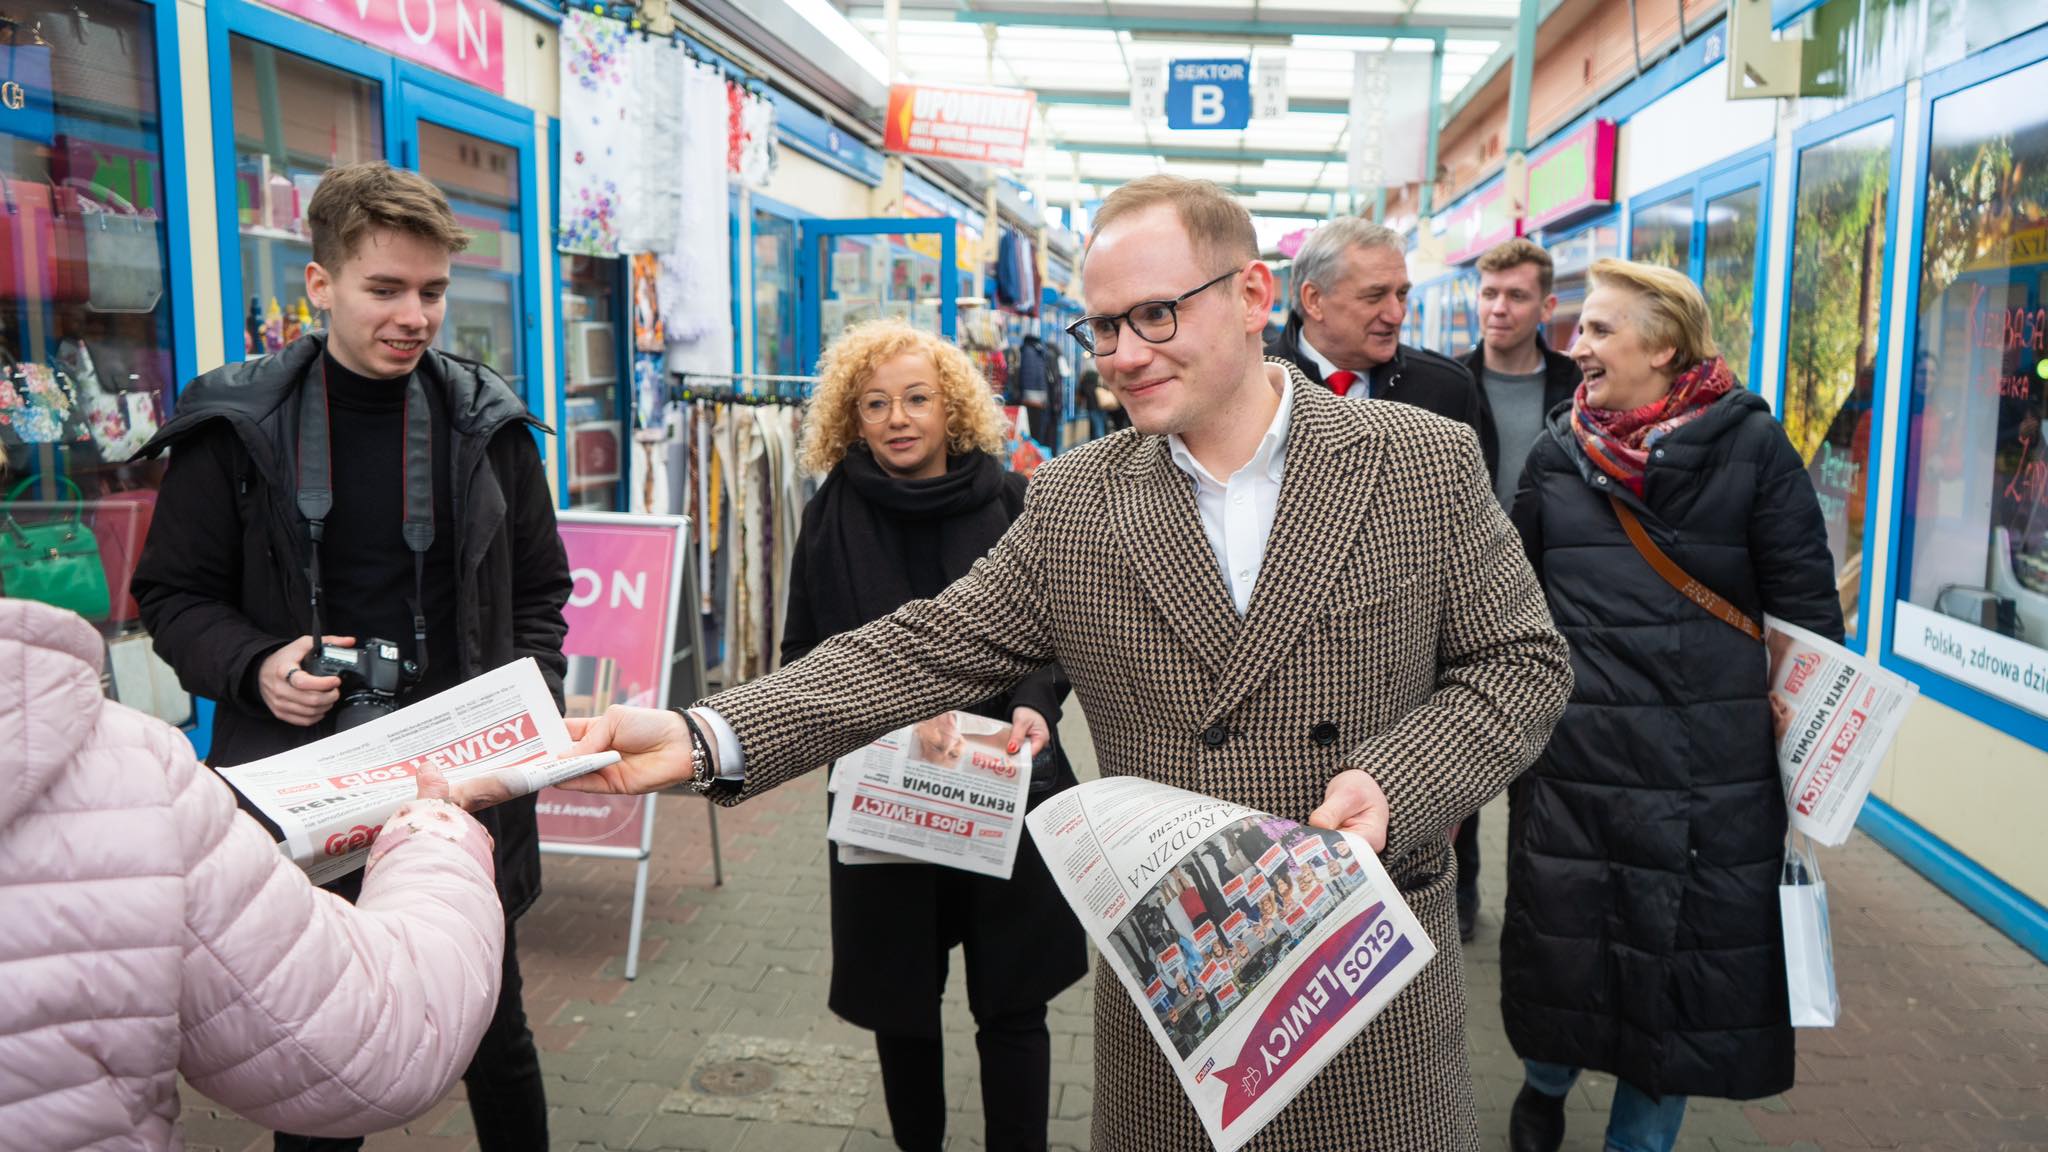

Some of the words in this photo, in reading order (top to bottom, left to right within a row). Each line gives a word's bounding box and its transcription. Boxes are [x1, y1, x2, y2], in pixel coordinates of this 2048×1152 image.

[1174, 64, 1245, 81] SEKTOR
[1190, 84, 1227, 125] B
[1924, 627, 1966, 668] Polska,
[1969, 645, 2020, 682] zdrowa
[1824, 664, 1856, 708] RENTA
[1790, 708, 1831, 765] WDOWIA
[902, 775, 965, 800] WDOWIA
[969, 792, 1016, 813] RENTA
[856, 797, 927, 825] LEWICY
[1127, 814, 1217, 889] RODZINA
[1343, 919, 1395, 984] GŁOS
[1259, 964, 1340, 1076] LEWICY
